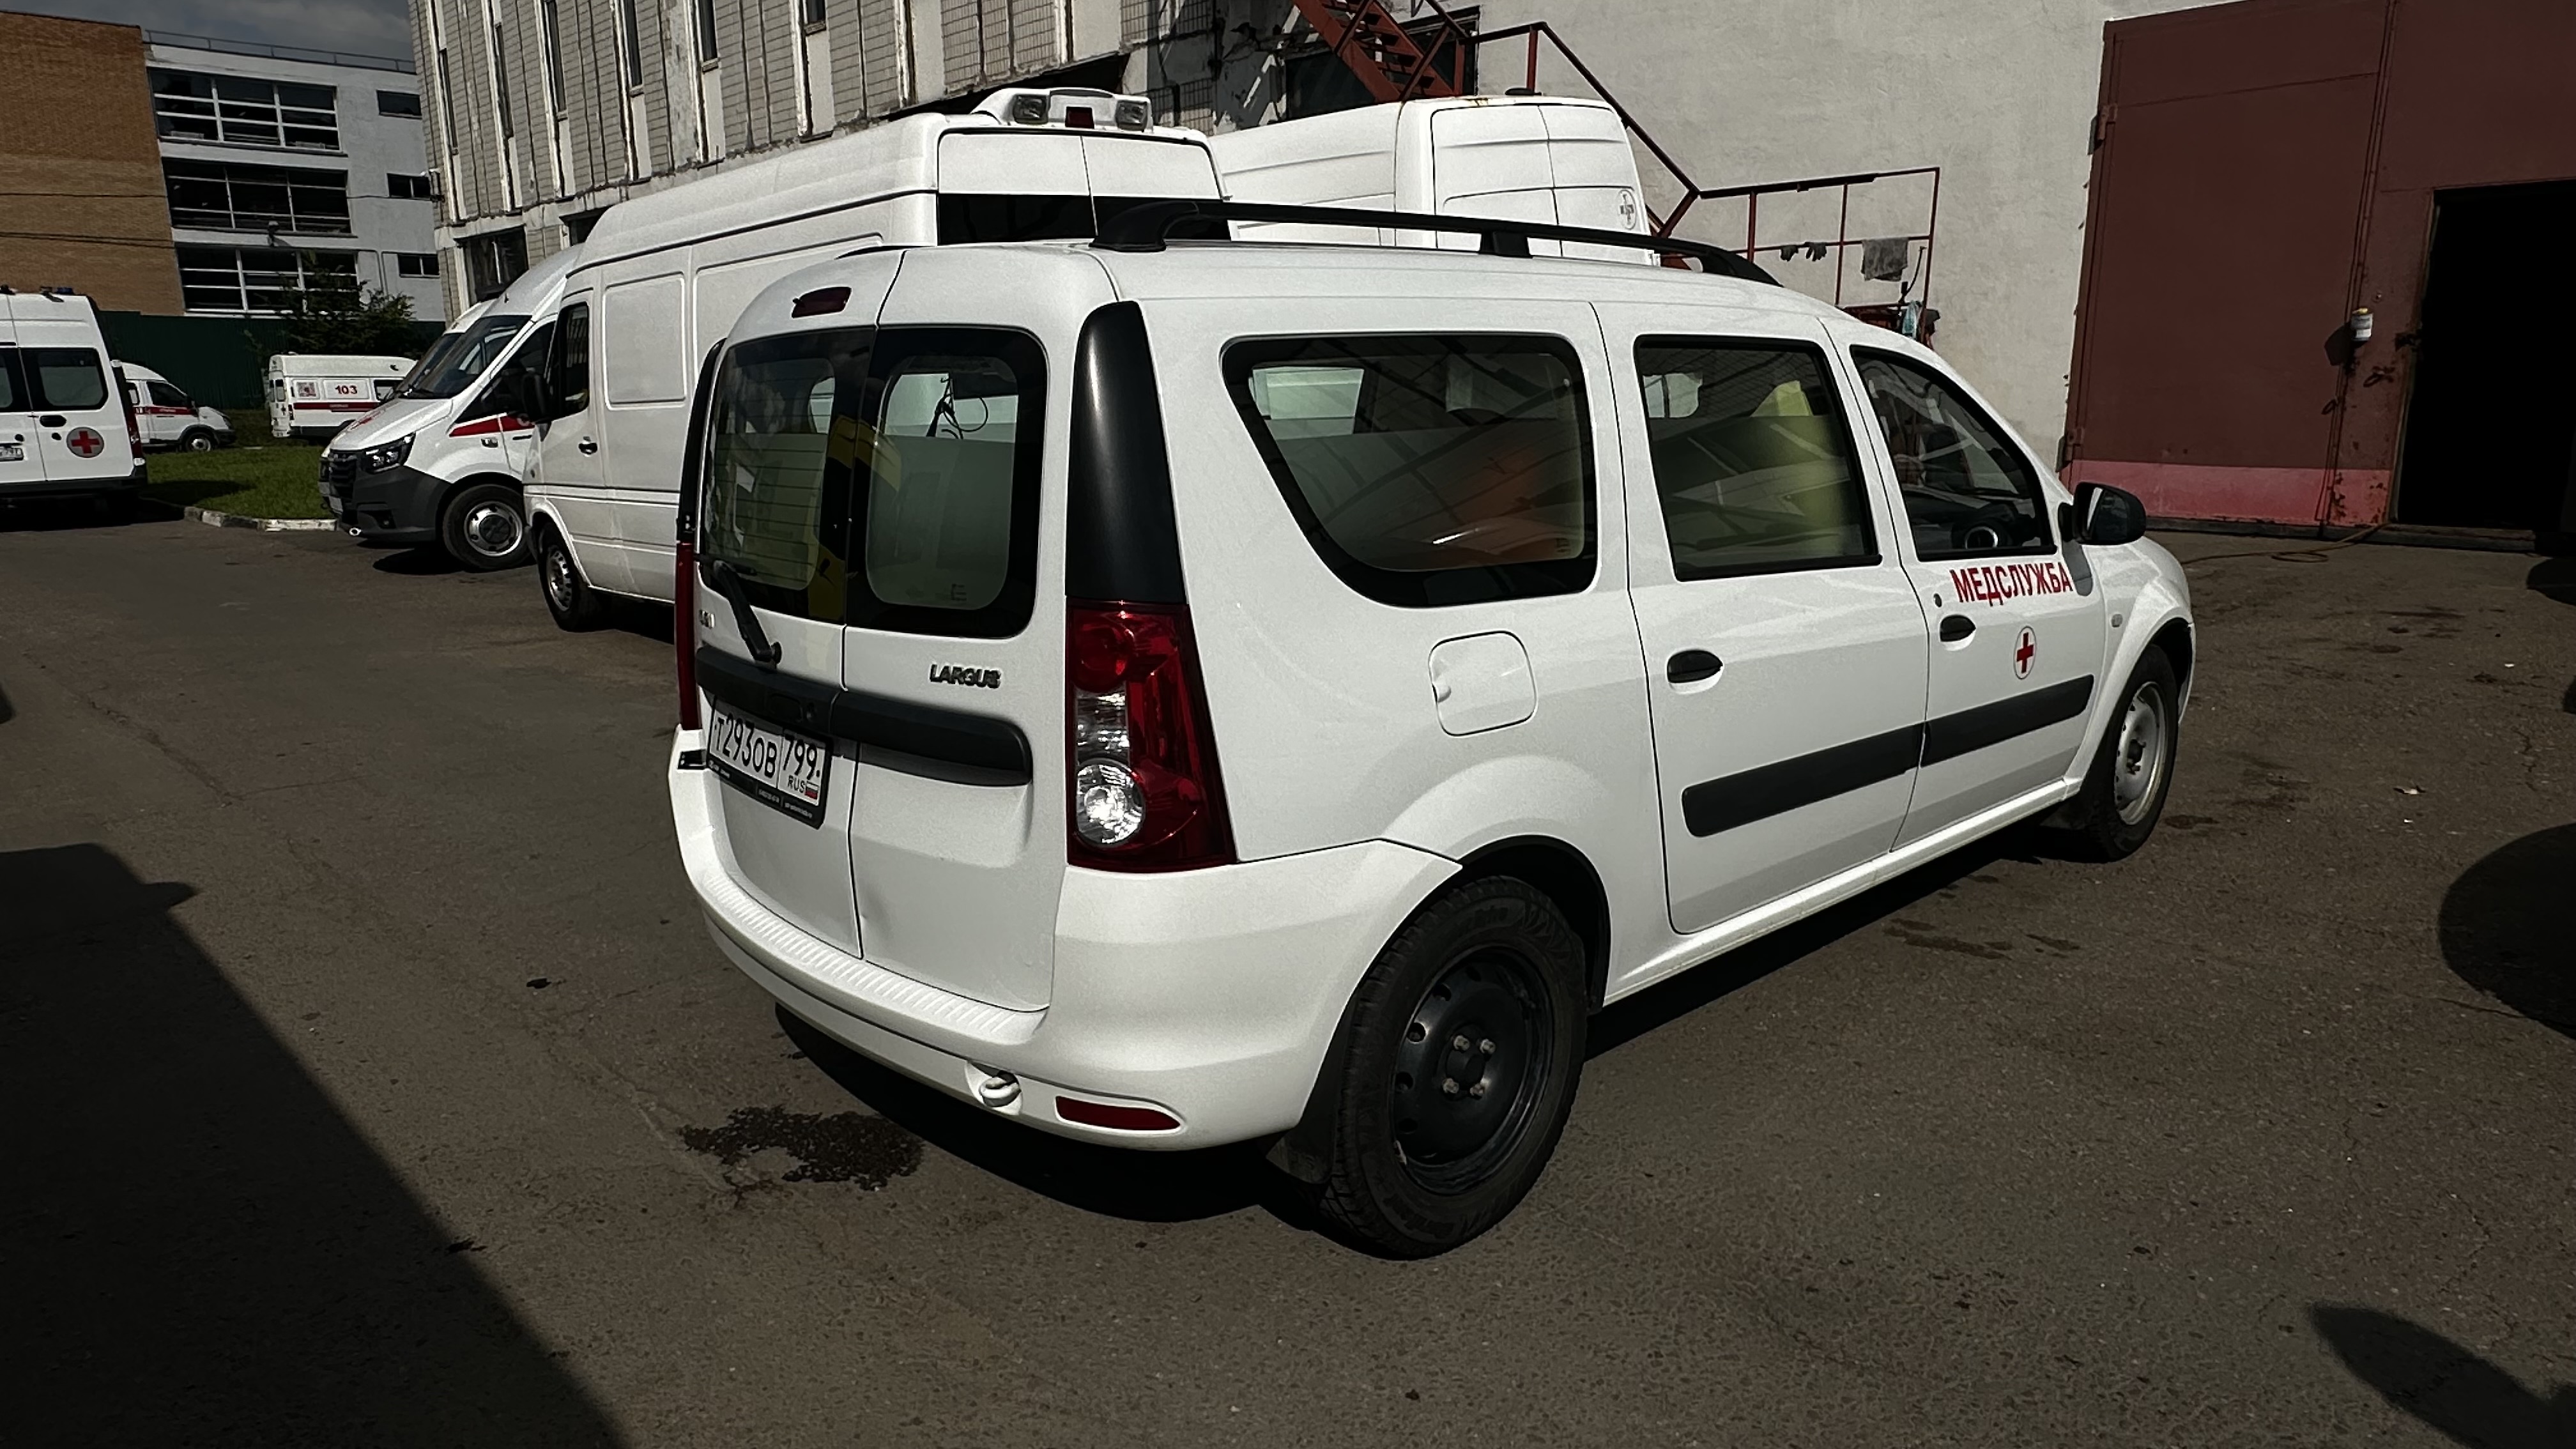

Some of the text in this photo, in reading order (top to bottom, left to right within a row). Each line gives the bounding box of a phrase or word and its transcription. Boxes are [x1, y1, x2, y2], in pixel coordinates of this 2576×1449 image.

[335, 385, 358, 395] 103
[1949, 562, 2073, 606] МЕДСЛУЖБА
[930, 663, 1002, 689] LARGUS
[717, 713, 817, 780] Т293ОВ 799
[787, 774, 806, 793] RUS
